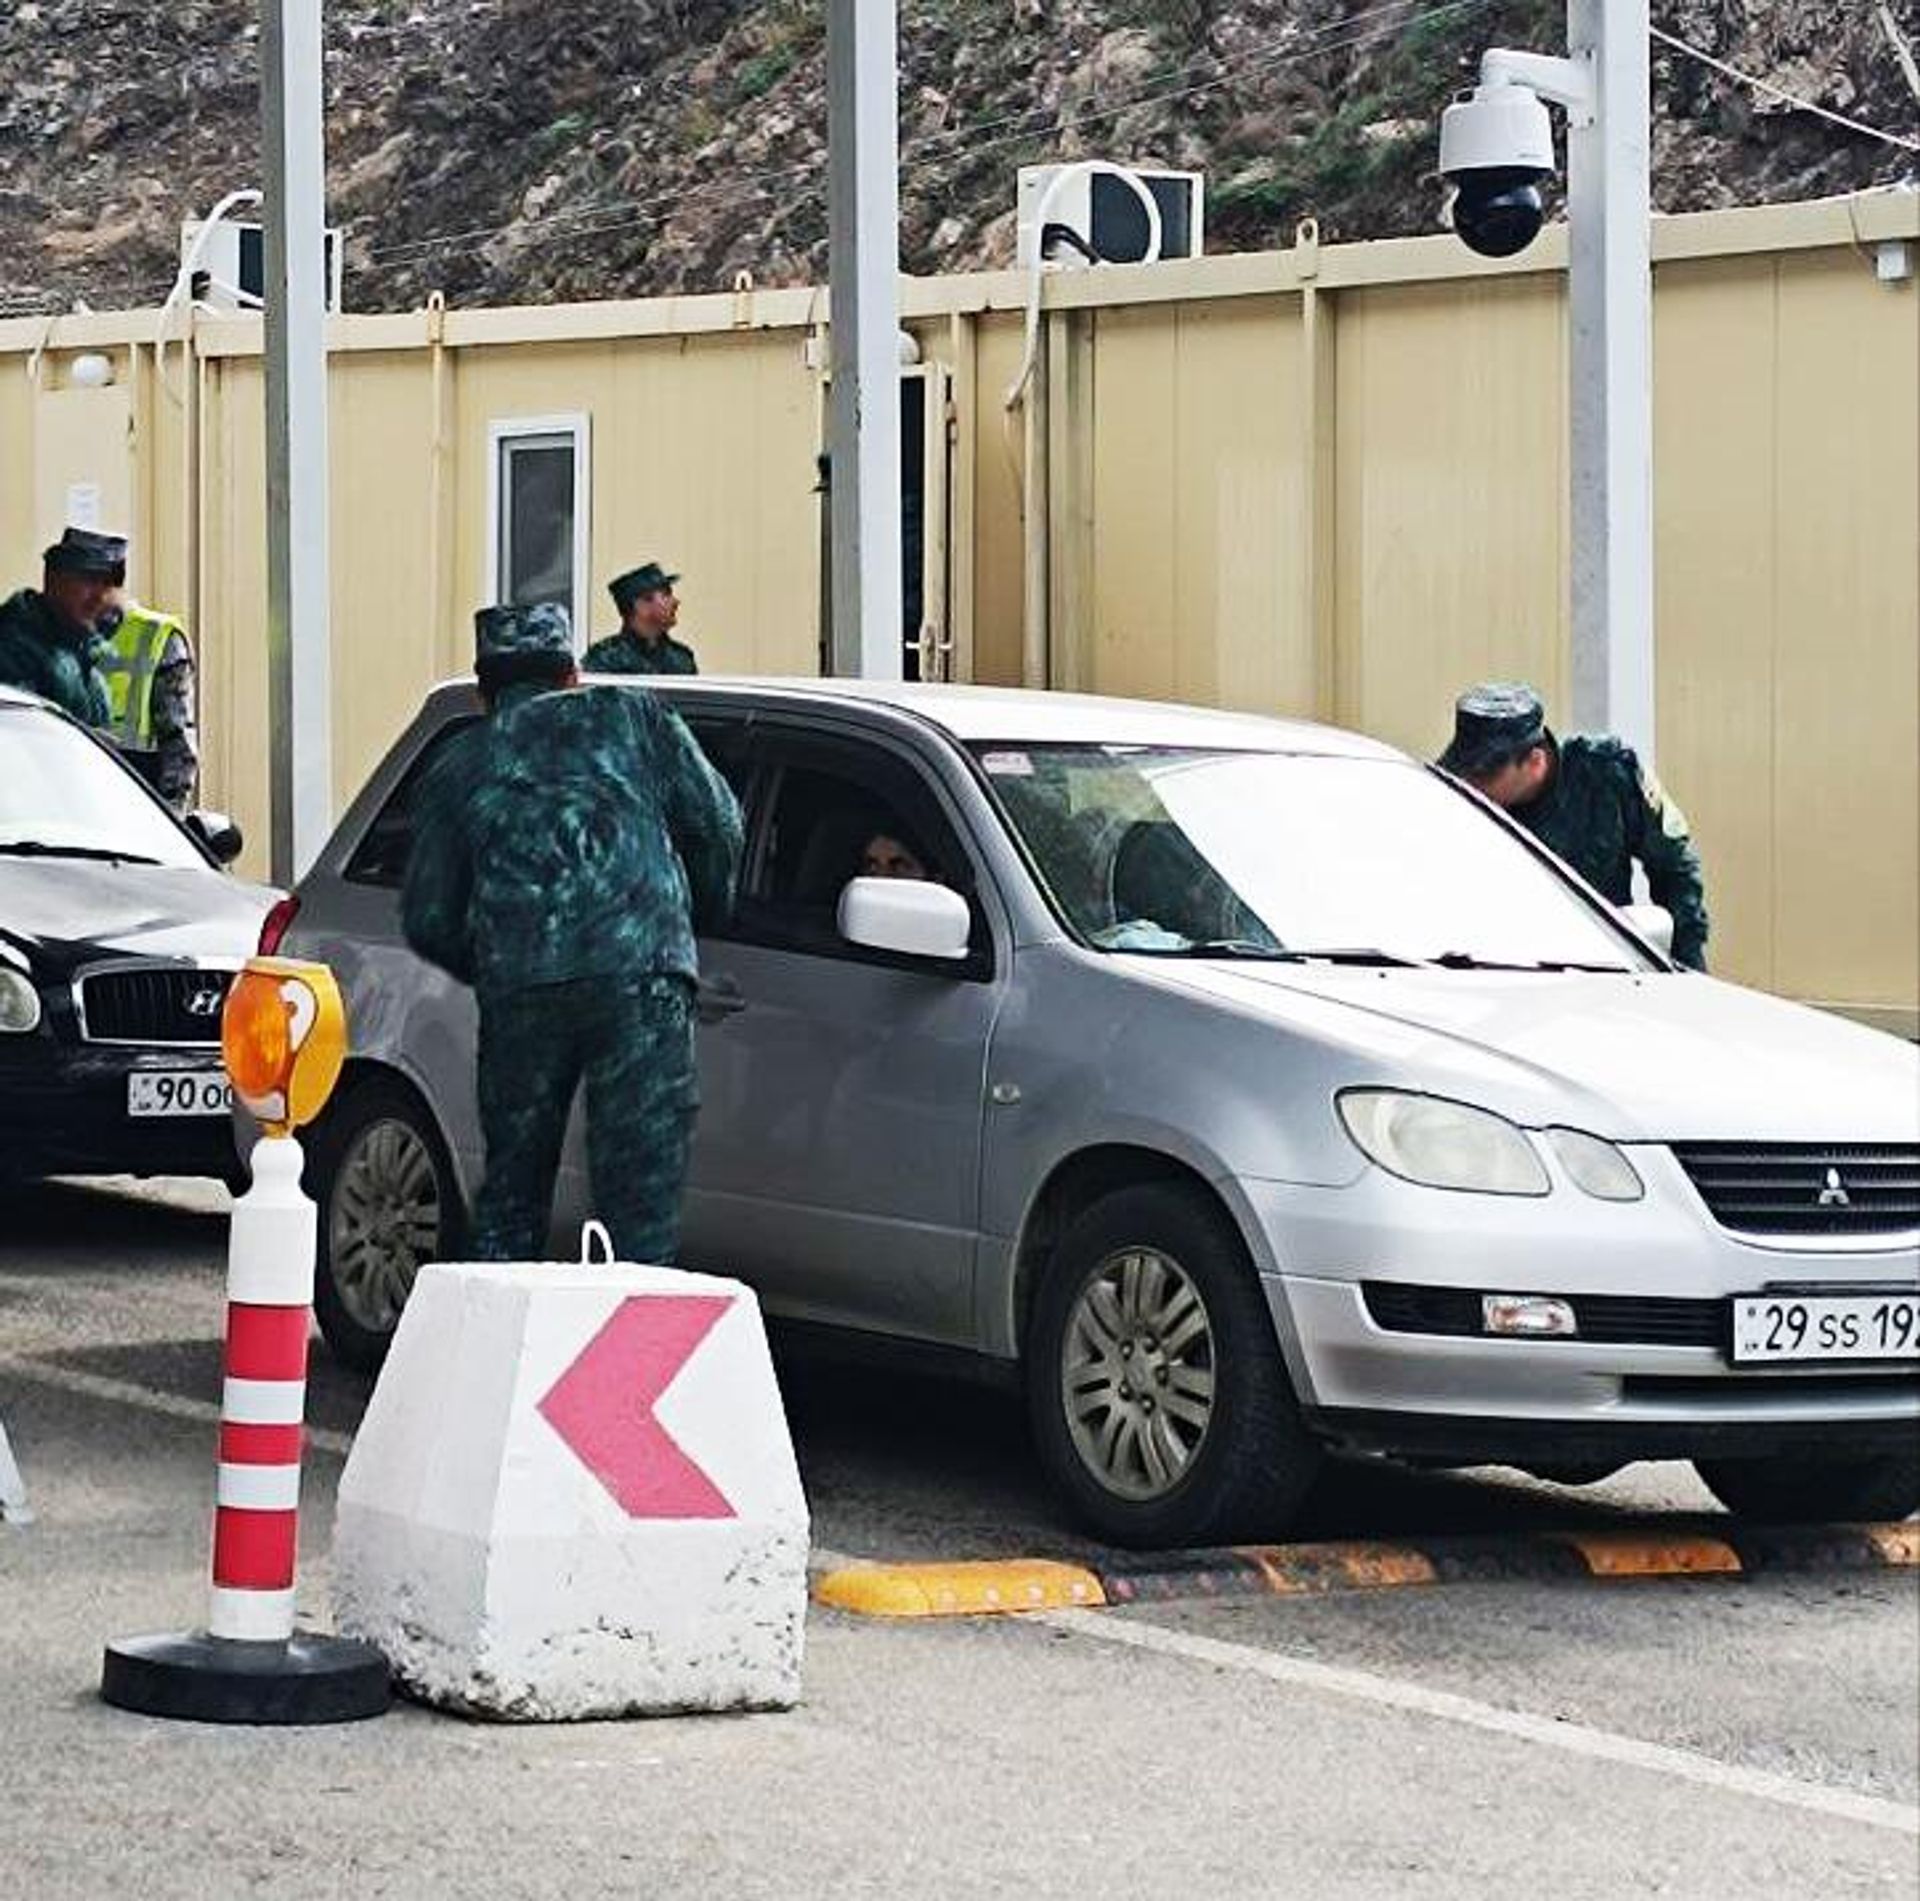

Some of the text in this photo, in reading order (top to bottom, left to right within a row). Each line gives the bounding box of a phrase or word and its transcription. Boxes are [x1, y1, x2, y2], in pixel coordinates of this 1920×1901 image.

[156, 1078, 195, 1110] 90
[1765, 1304, 1809, 1349] 29
[1873, 1303, 1920, 1349] 19
